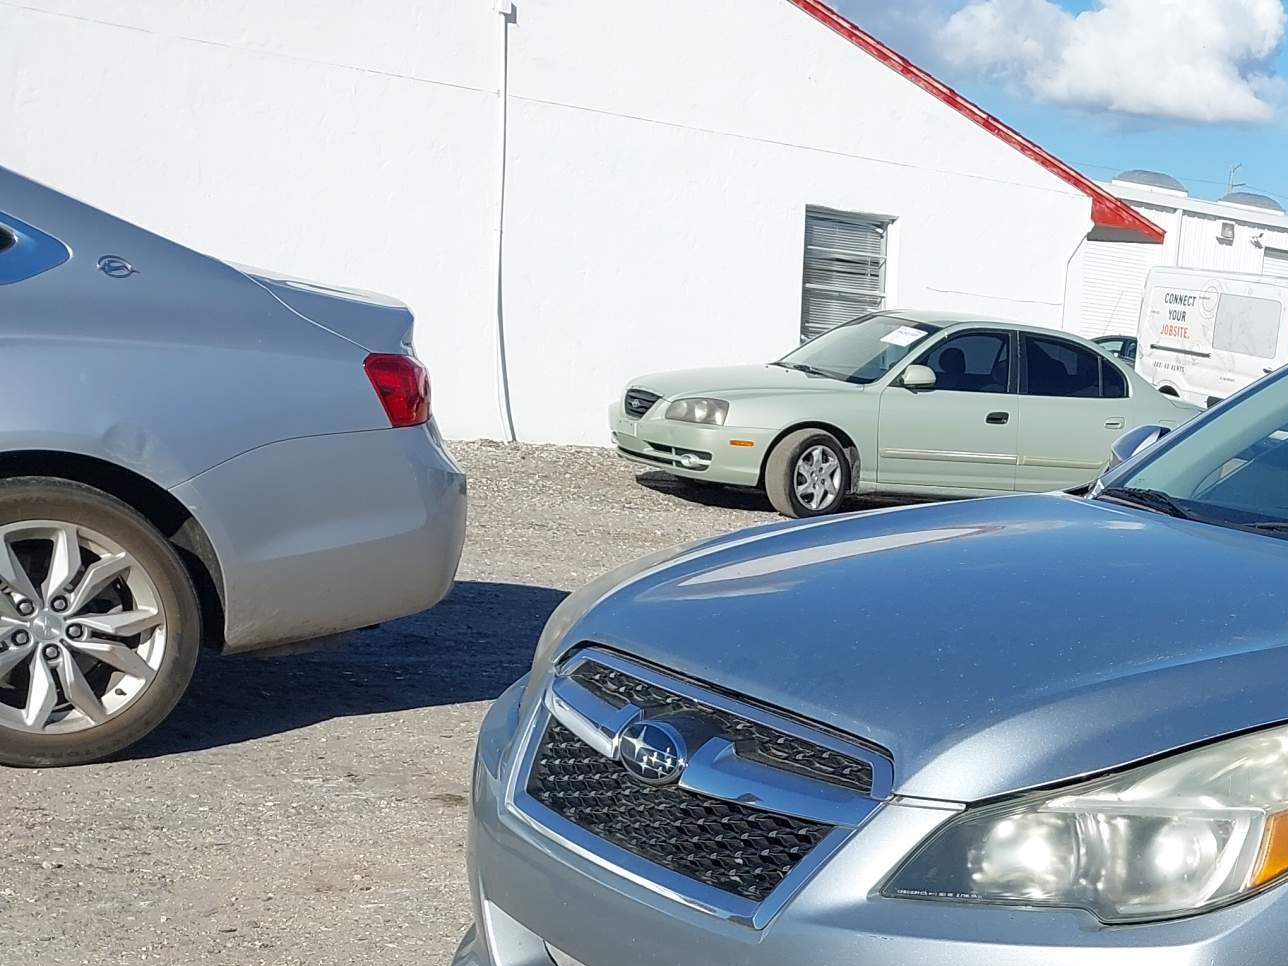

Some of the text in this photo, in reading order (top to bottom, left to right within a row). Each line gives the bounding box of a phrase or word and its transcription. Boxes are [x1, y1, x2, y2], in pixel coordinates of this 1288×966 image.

[1164, 293, 1196, 307] CONNECT
[1168, 309, 1187, 322] YOUR
[1161, 324, 1190, 339] JOBSITE.
